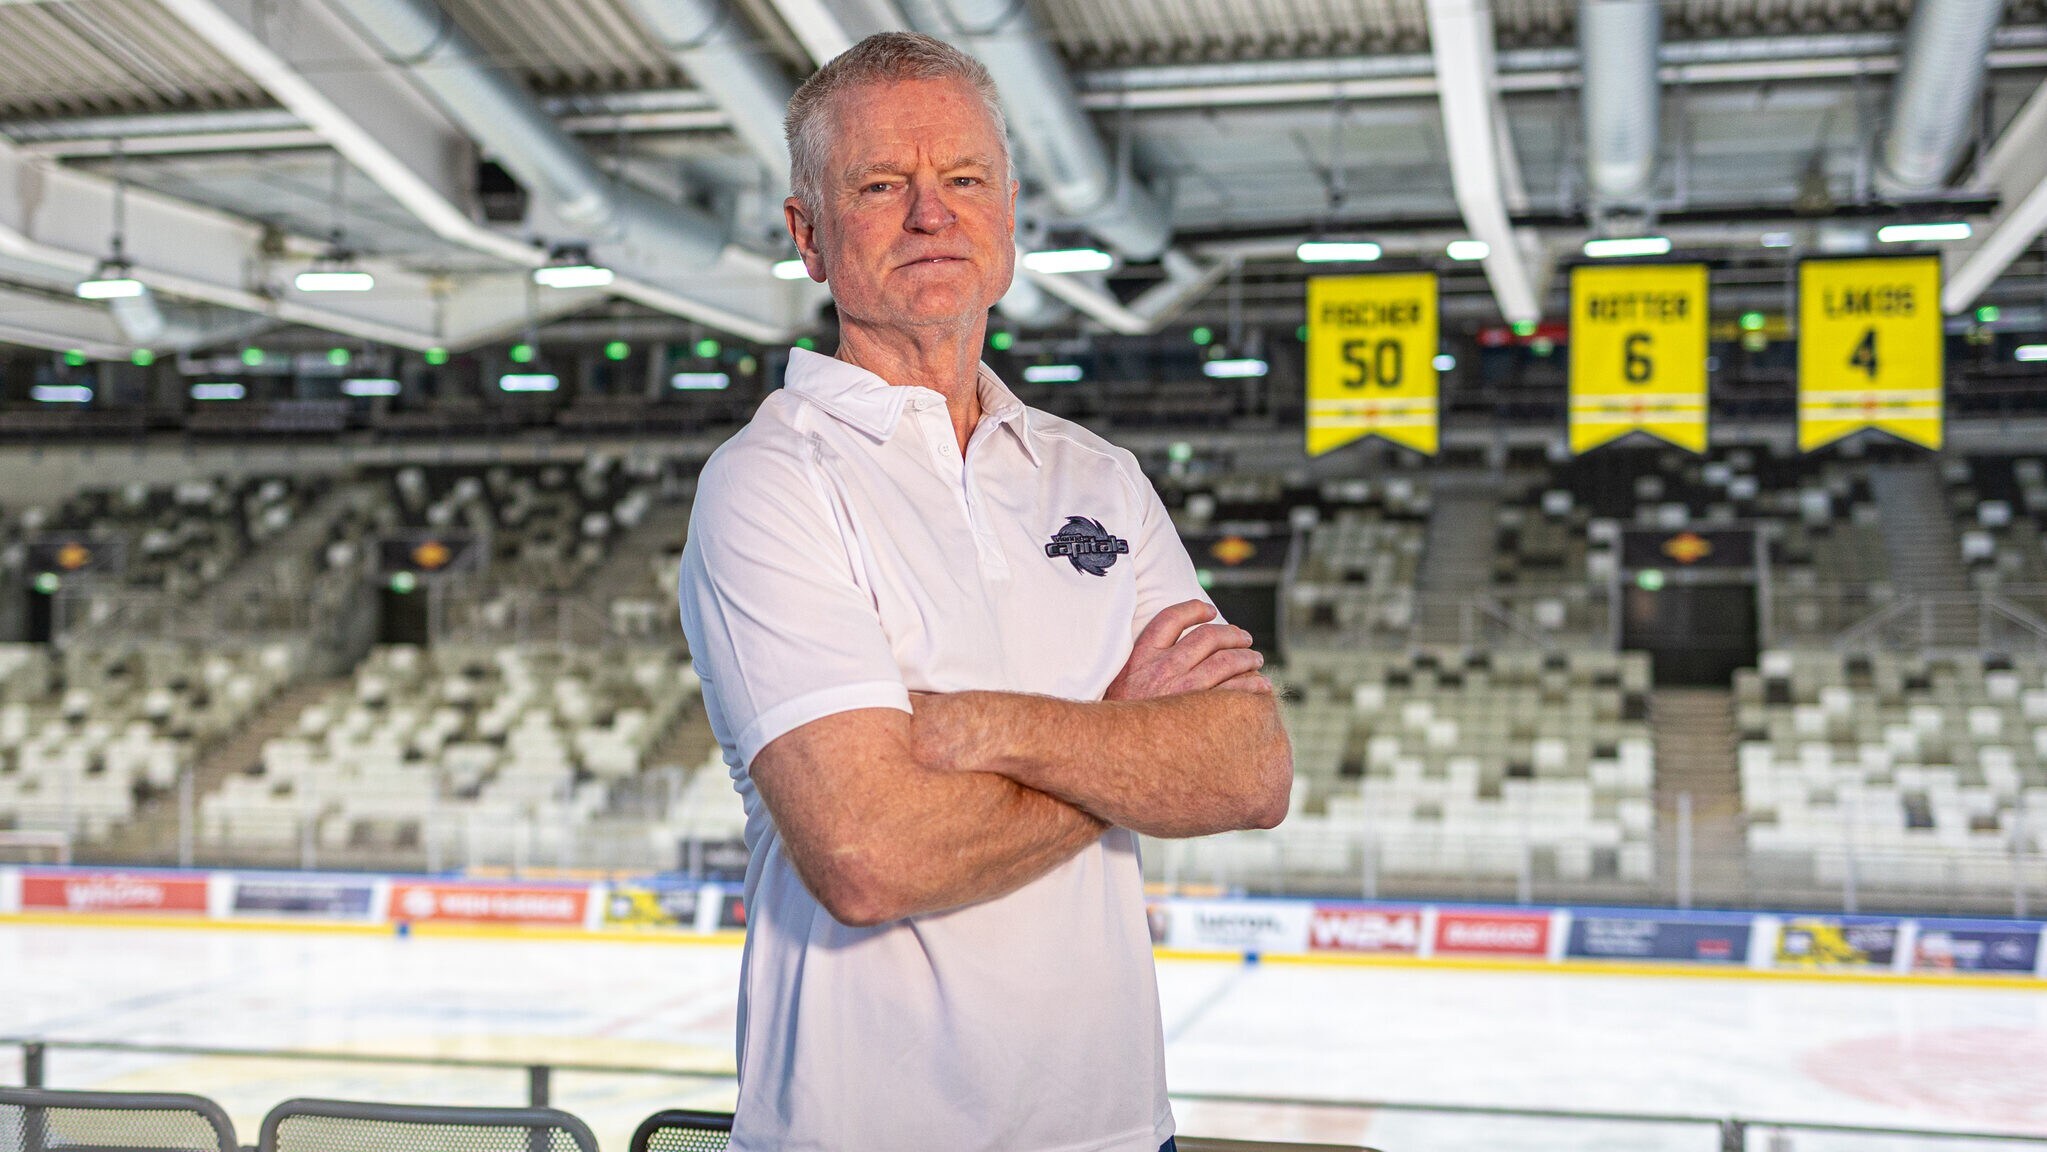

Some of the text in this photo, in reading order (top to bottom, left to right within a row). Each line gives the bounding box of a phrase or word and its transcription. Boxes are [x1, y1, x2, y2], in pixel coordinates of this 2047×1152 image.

[1320, 300, 1422, 328] FISCHER
[1588, 292, 1688, 323] ROTTER
[1341, 337, 1404, 389] 50
[1623, 332, 1654, 385] 6
[1847, 326, 1879, 380] 4
